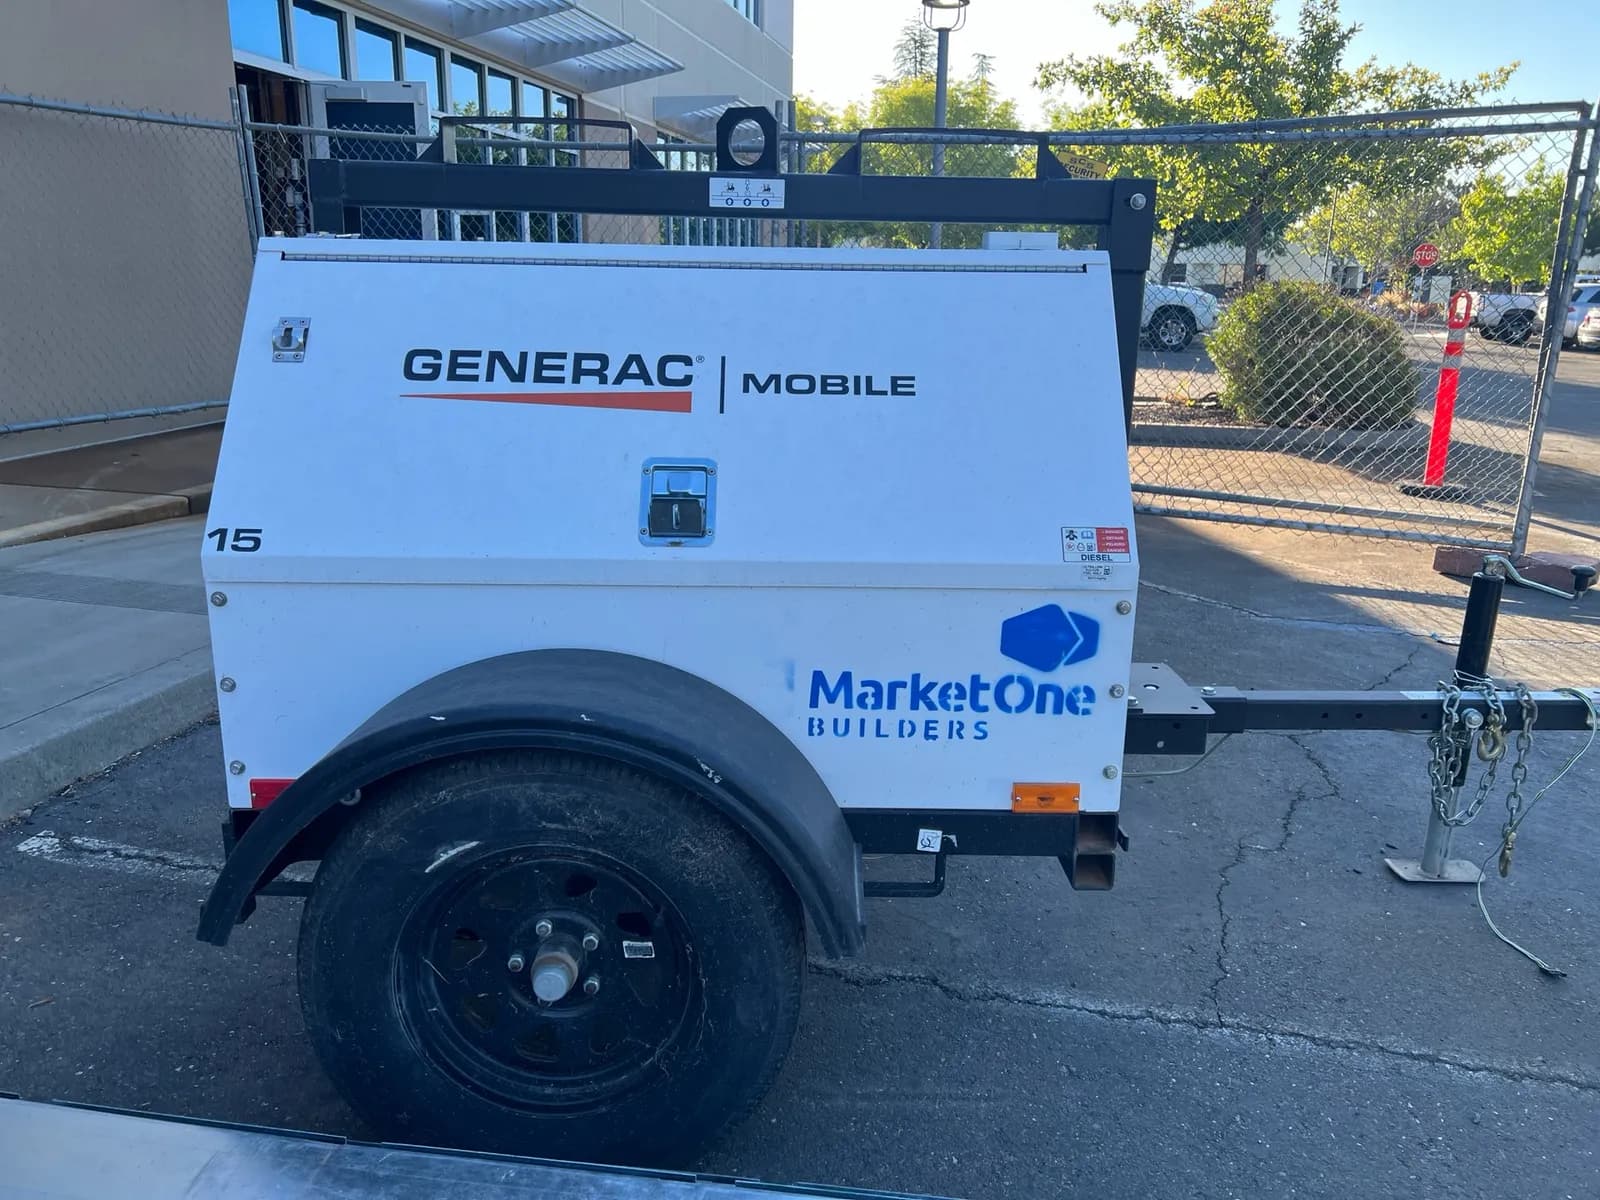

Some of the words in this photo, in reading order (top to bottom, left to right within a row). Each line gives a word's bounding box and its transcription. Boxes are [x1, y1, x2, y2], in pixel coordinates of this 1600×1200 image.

[1415, 250, 1438, 261] STOP
[403, 349, 694, 387] GENERAC
[742, 373, 917, 396] MOBILE
[208, 528, 263, 552] 15
[809, 670, 1096, 716] MarketOne
[808, 717, 989, 741] BUILDERS
